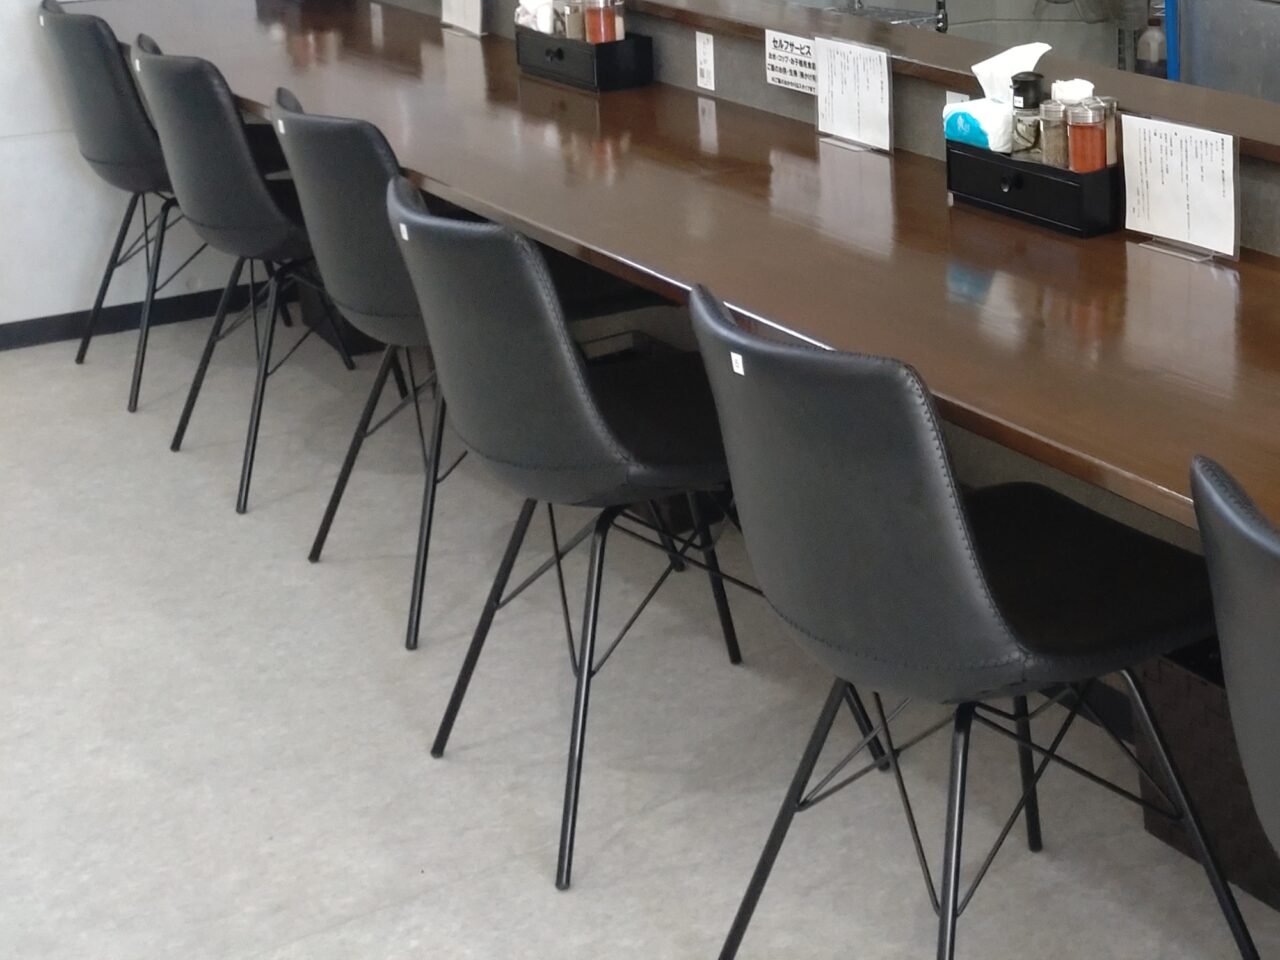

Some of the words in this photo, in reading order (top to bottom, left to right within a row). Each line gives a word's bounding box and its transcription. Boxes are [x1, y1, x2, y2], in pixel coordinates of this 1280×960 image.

[772, 37, 812, 57] セルフサービス
